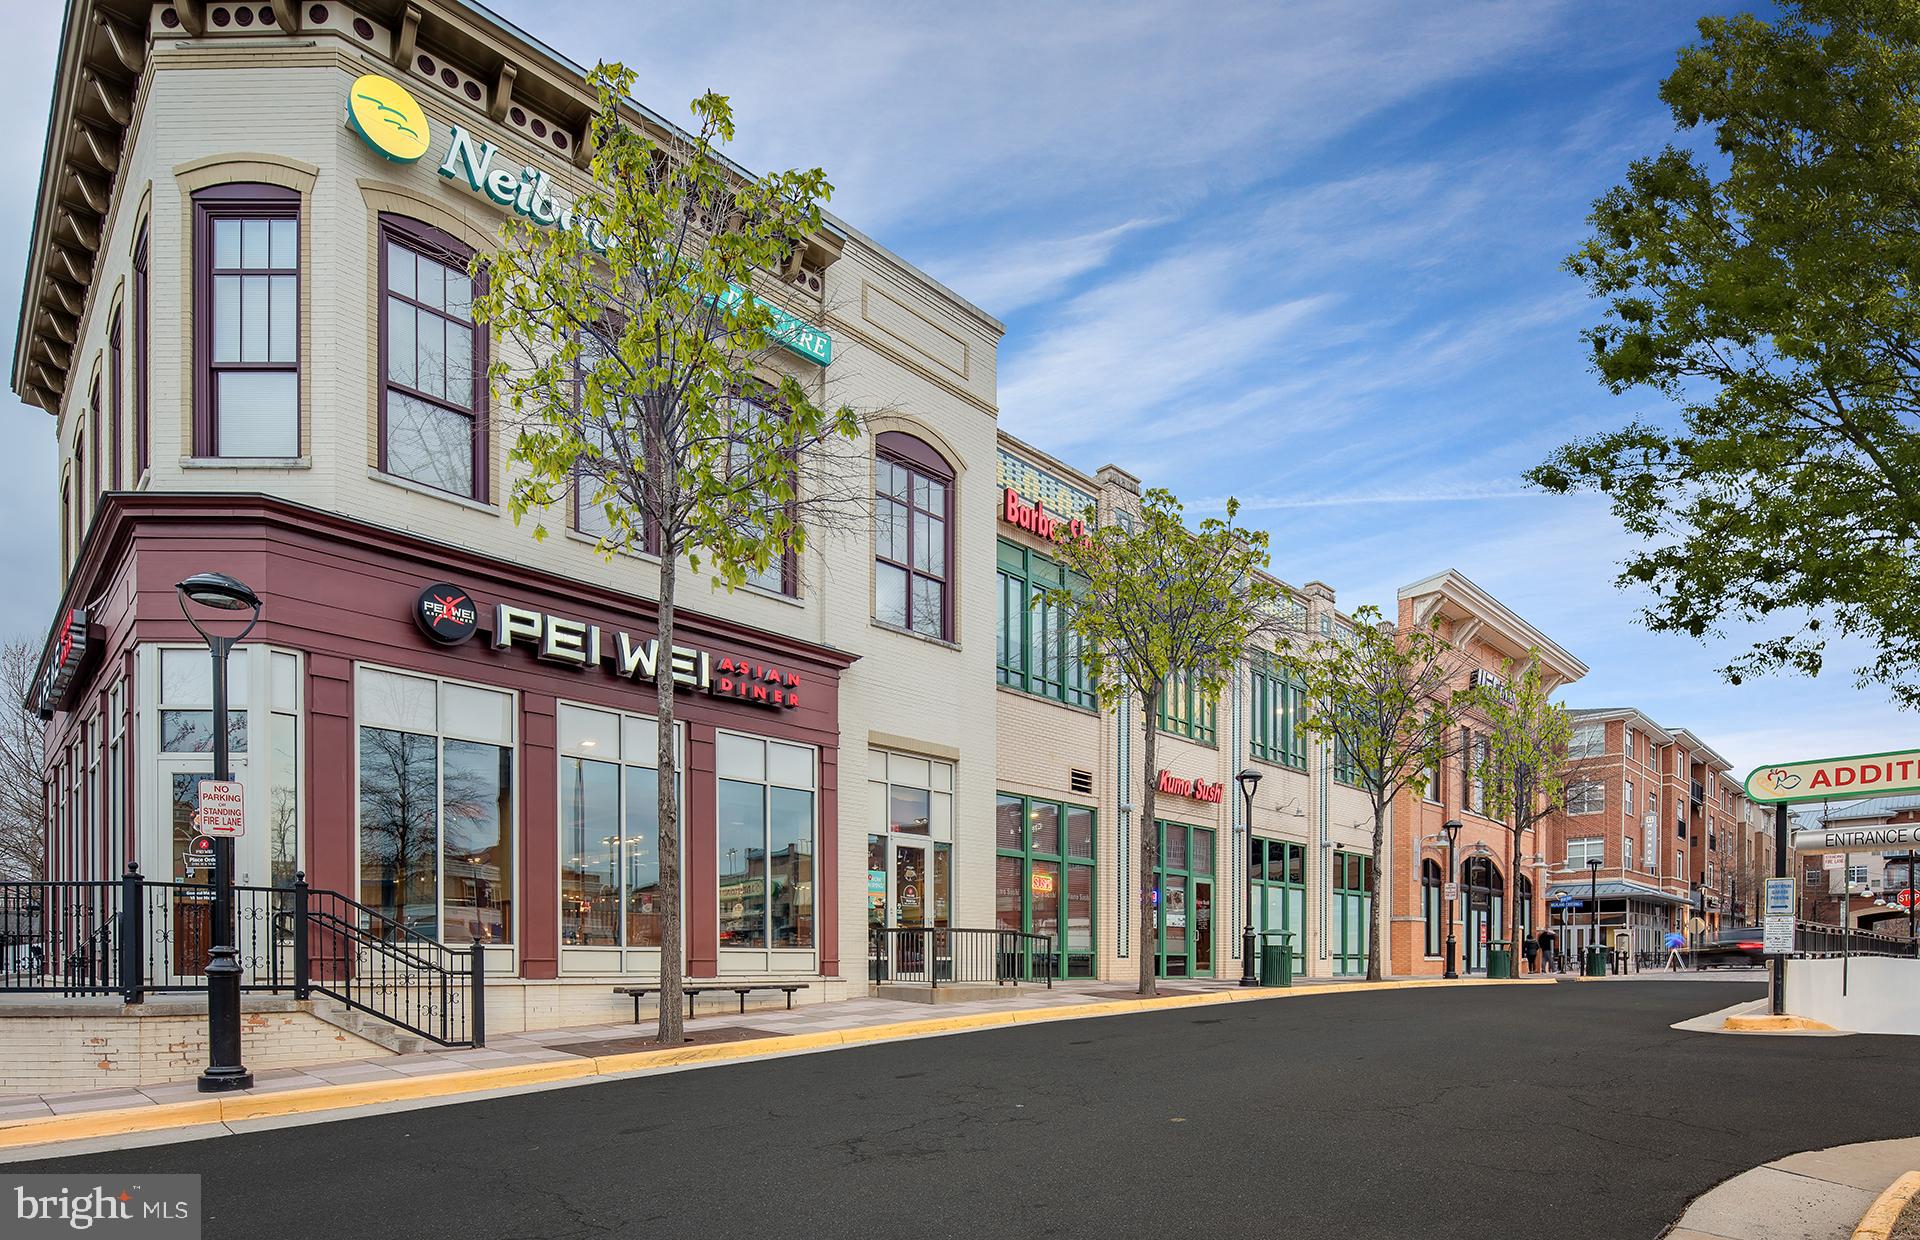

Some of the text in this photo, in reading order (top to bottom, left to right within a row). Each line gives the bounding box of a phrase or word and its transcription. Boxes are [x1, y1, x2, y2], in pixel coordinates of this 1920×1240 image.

[1004, 488, 1064, 545] Barbe
[424, 600, 475, 620] PEI WEI
[496, 603, 710, 689] PEI WEI
[719, 657, 800, 687] ASIAN
[719, 677, 800, 707] DINER
[213, 785, 229, 793] NO
[1159, 769, 1225, 804] Kumo Sushi
[202, 793, 241, 803] PARKING
[203, 807, 242, 817] STANDING
[203, 816, 242, 827] FIRE LANE
[1825, 828, 1908, 847] ENTRANCE
[1899, 894, 1920, 902] STP
